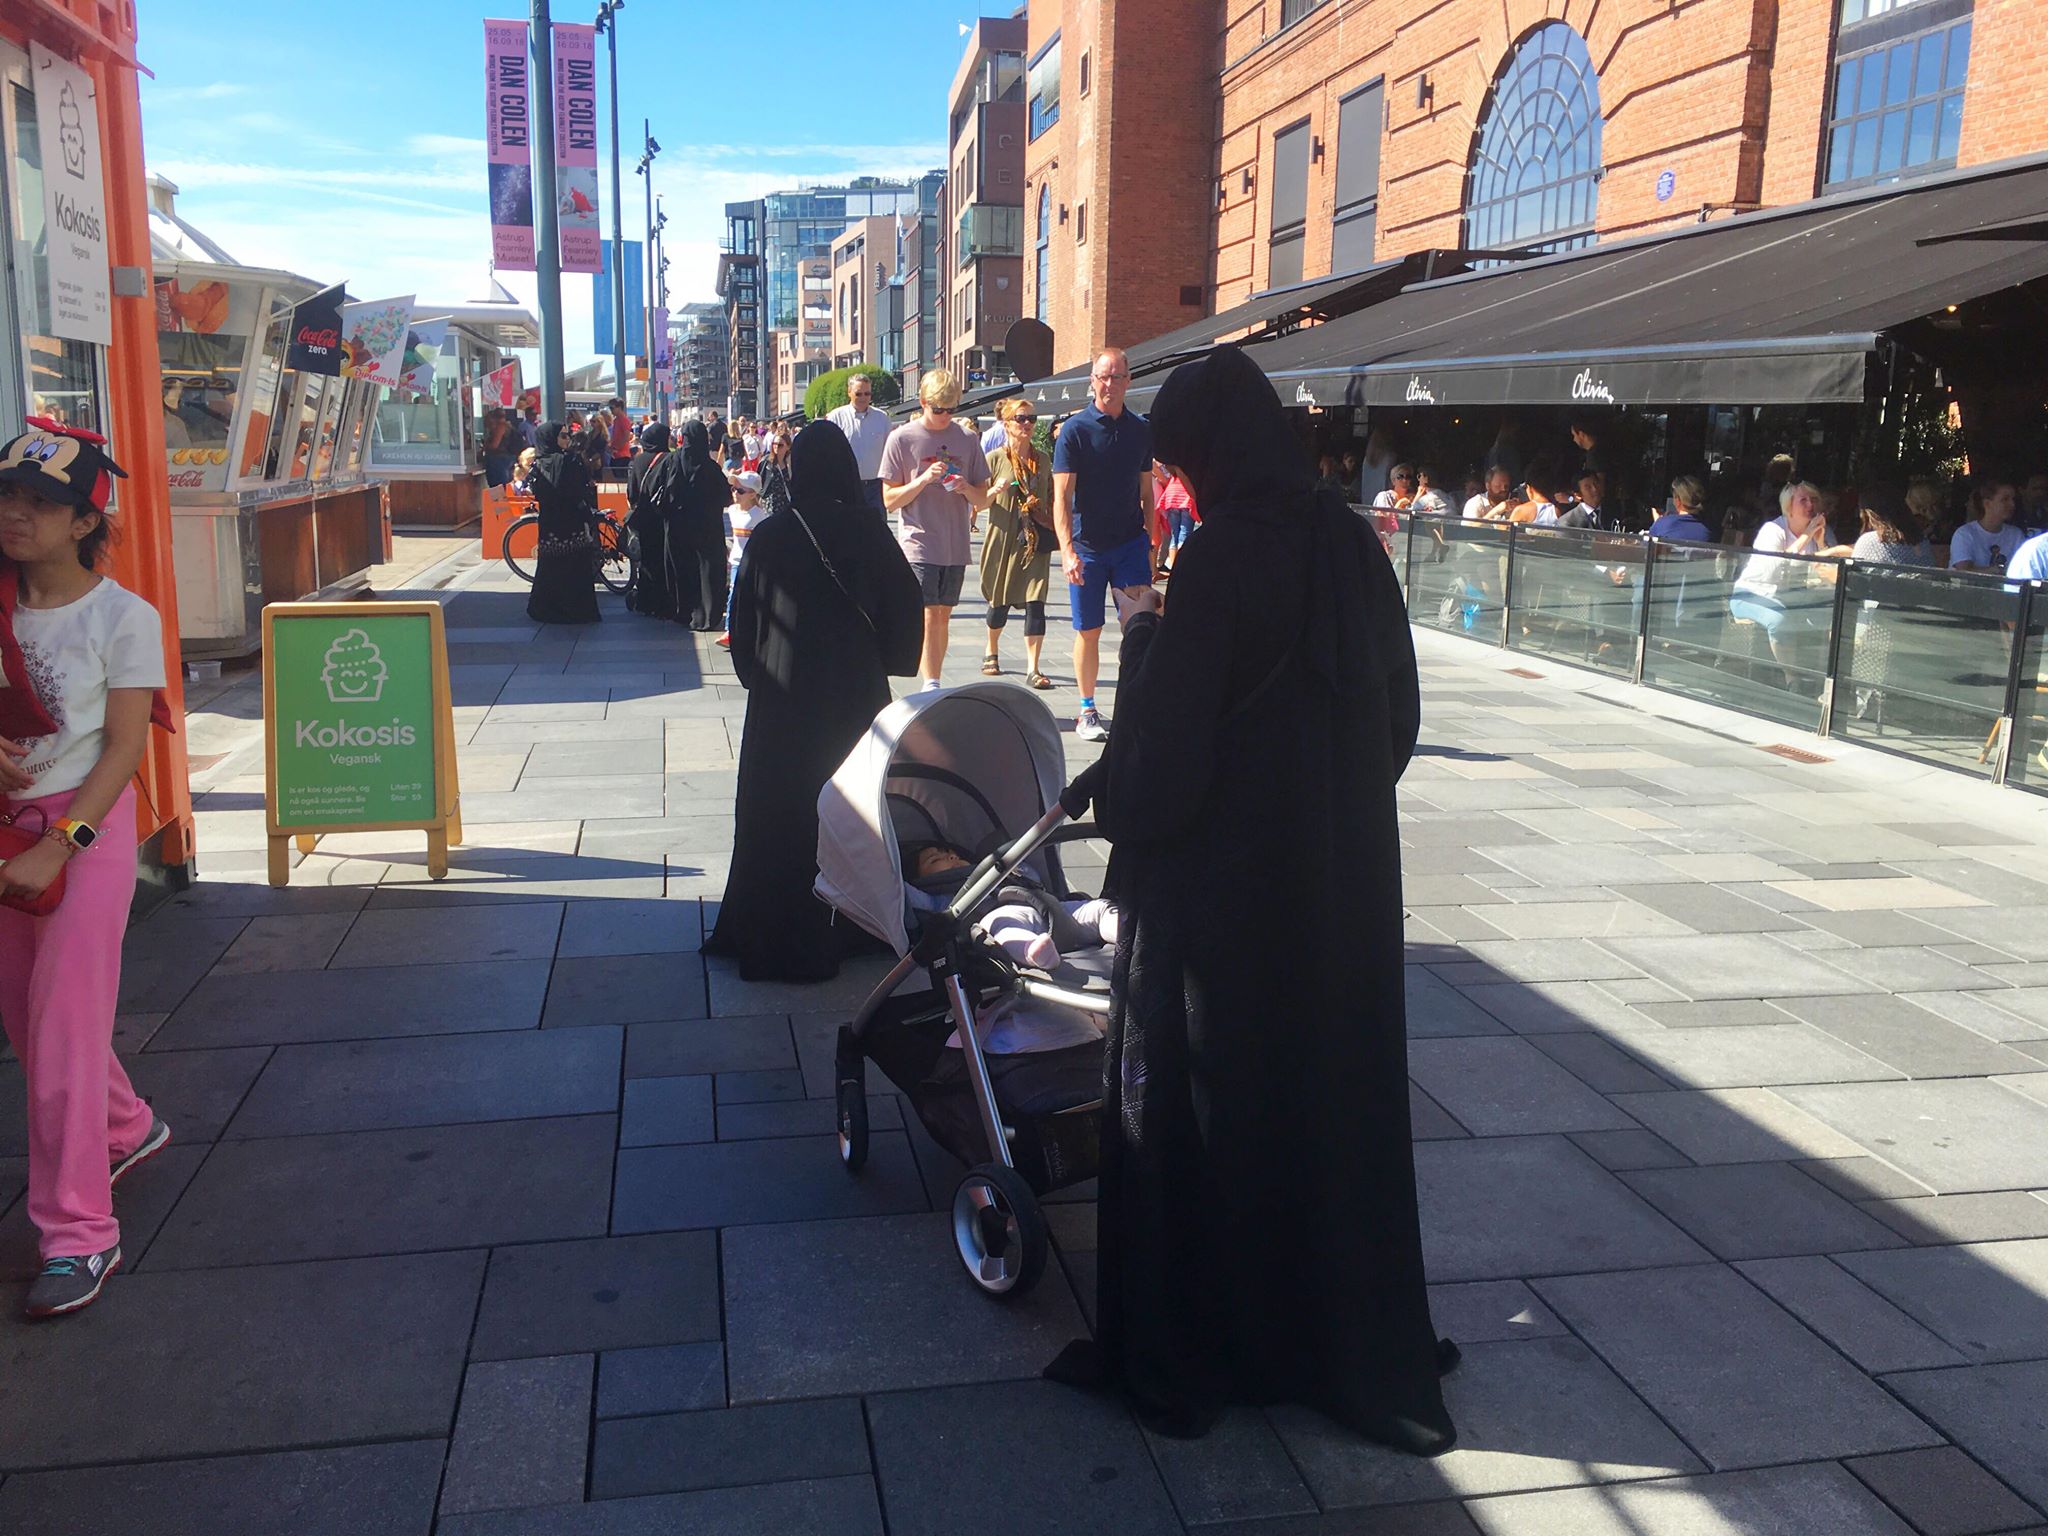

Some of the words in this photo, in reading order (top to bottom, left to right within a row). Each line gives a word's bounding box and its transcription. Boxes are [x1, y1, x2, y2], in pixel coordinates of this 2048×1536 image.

[500, 56, 525, 88] DAN
[568, 59, 593, 91] DAN
[500, 95, 526, 147] COLEN
[568, 98, 594, 149] COLEN
[55, 190, 101, 242] Kokosis
[495, 233, 525, 242] Astrup
[563, 235, 592, 244] Astrup
[496, 243, 531, 254] Fearnley
[496, 253, 529, 263] Museet
[564, 245, 599, 256] Fearnley
[564, 255, 596, 265] Museet
[297, 325, 338, 348] Coca-Cola
[308, 345, 328, 355] zero
[1406, 376, 1434, 404] Olivia
[1572, 368, 1614, 404] Olivia
[167, 470, 206, 487] ca-Cola
[295, 717, 416, 748] Kokosis
[329, 753, 382, 766] Vegansk
